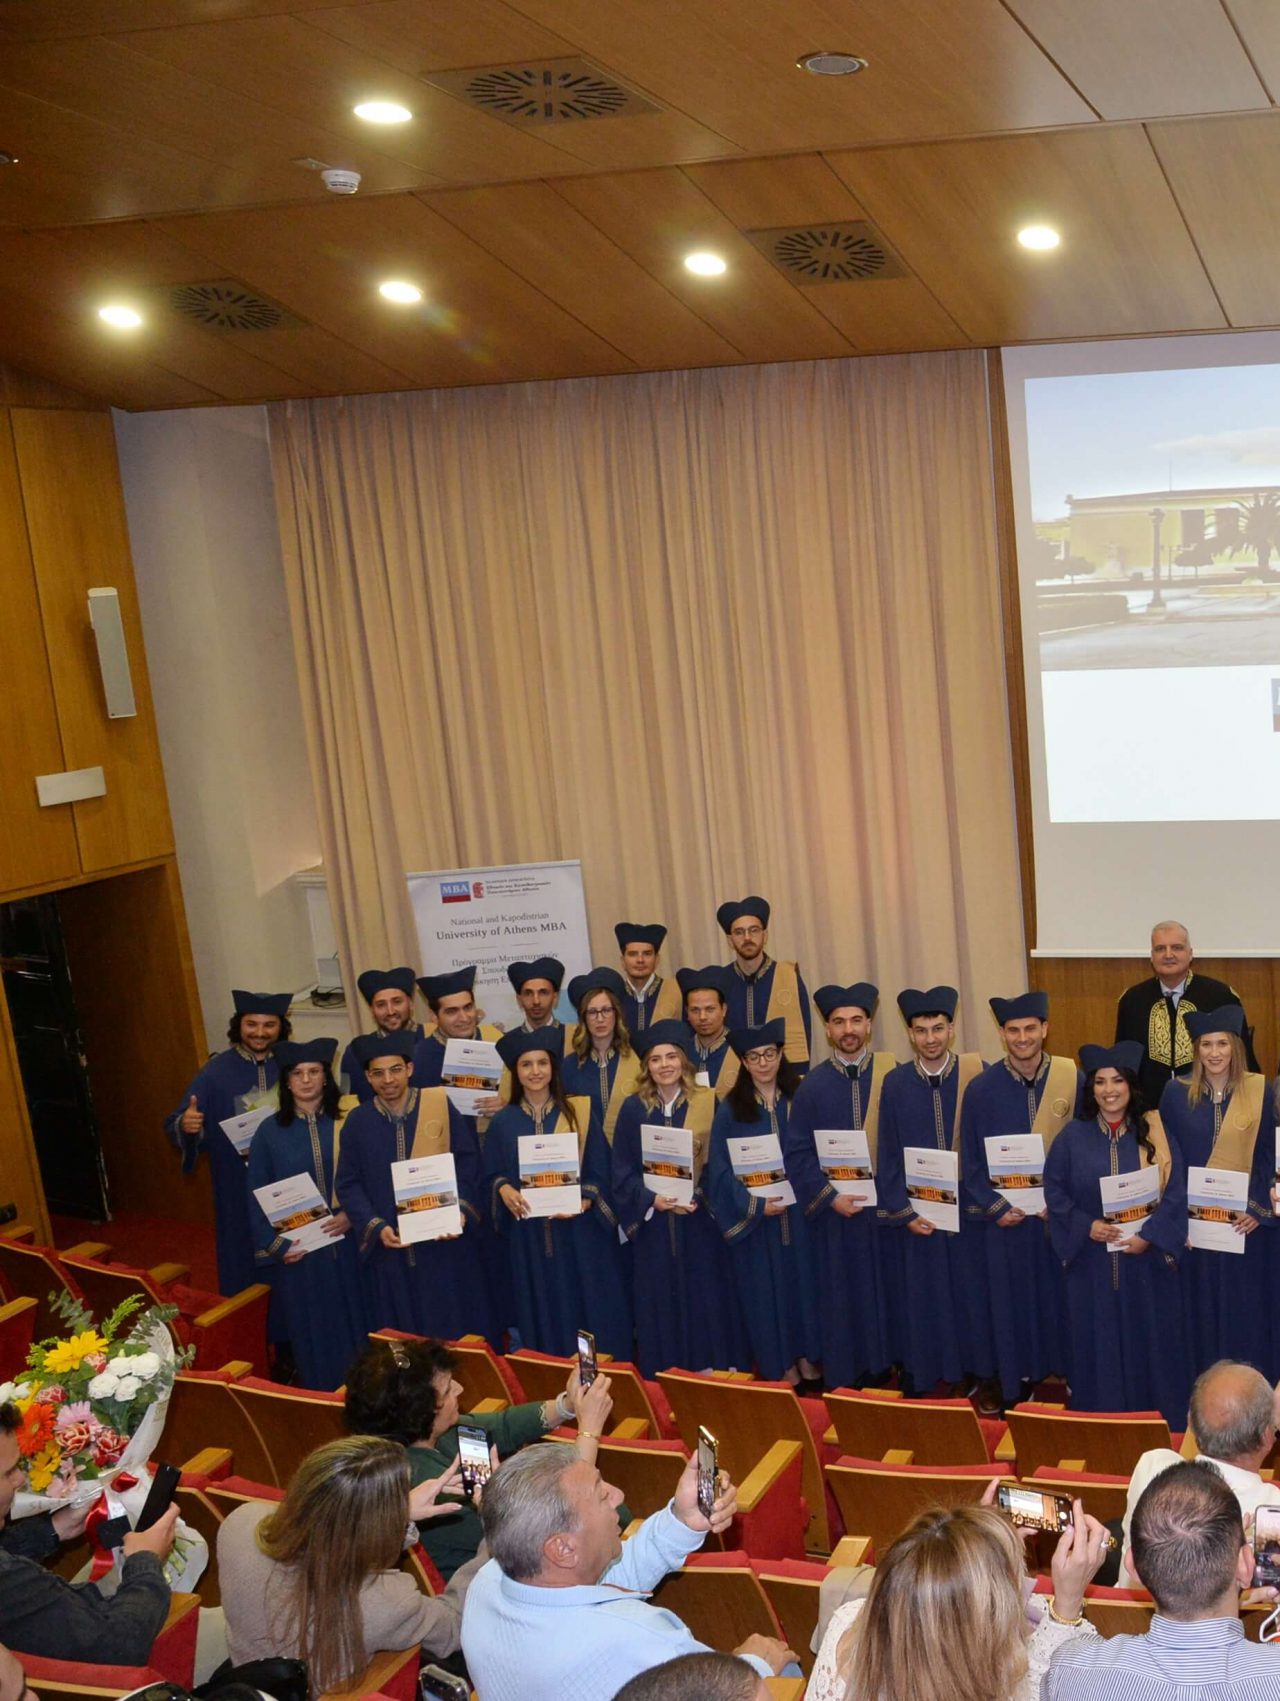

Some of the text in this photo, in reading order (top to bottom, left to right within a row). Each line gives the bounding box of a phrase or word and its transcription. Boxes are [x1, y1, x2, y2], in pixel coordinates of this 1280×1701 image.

[441, 884, 469, 895] MBA
[450, 912, 550, 927] National and Kapodistrian
[436, 921, 568, 940] University of Athens MBA
